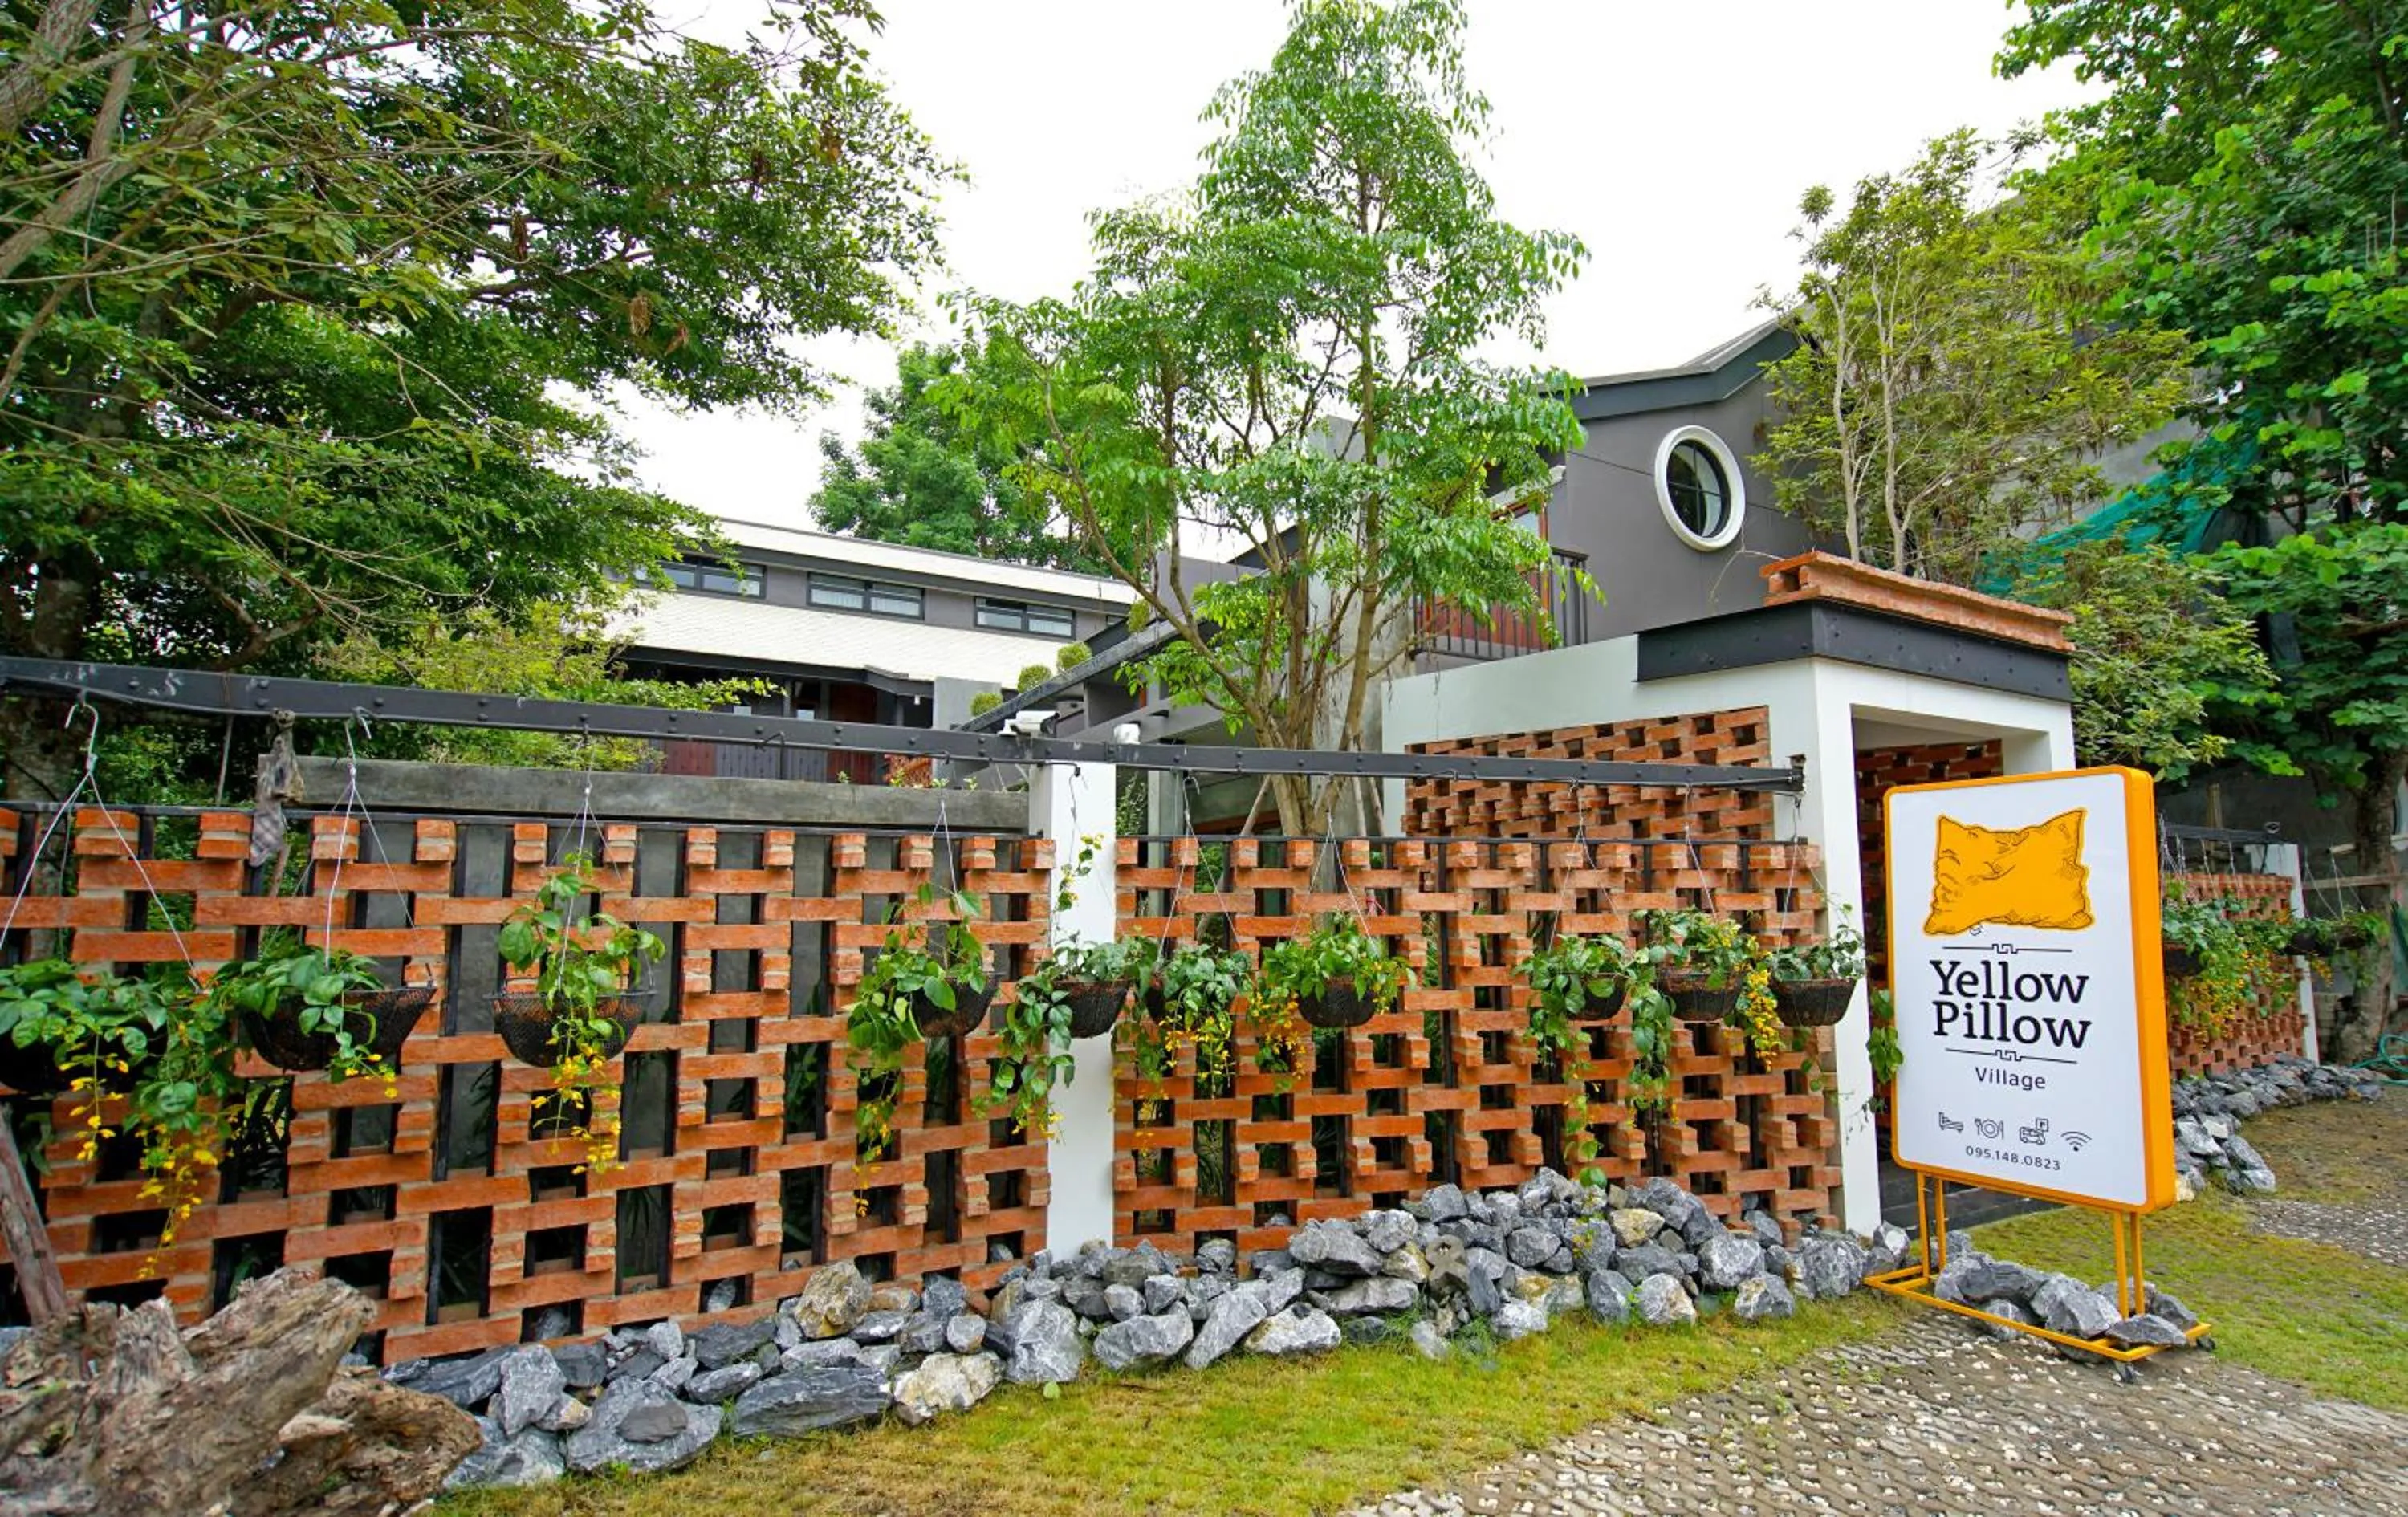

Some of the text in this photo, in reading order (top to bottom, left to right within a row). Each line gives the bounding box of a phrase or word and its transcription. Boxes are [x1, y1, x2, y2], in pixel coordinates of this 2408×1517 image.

[1929, 960, 2089, 1003] Yellow
[1932, 1001, 2093, 1048] Pillow
[1975, 1067, 2046, 1091] Village
[1966, 1145, 2061, 1170] 095.148.0823
